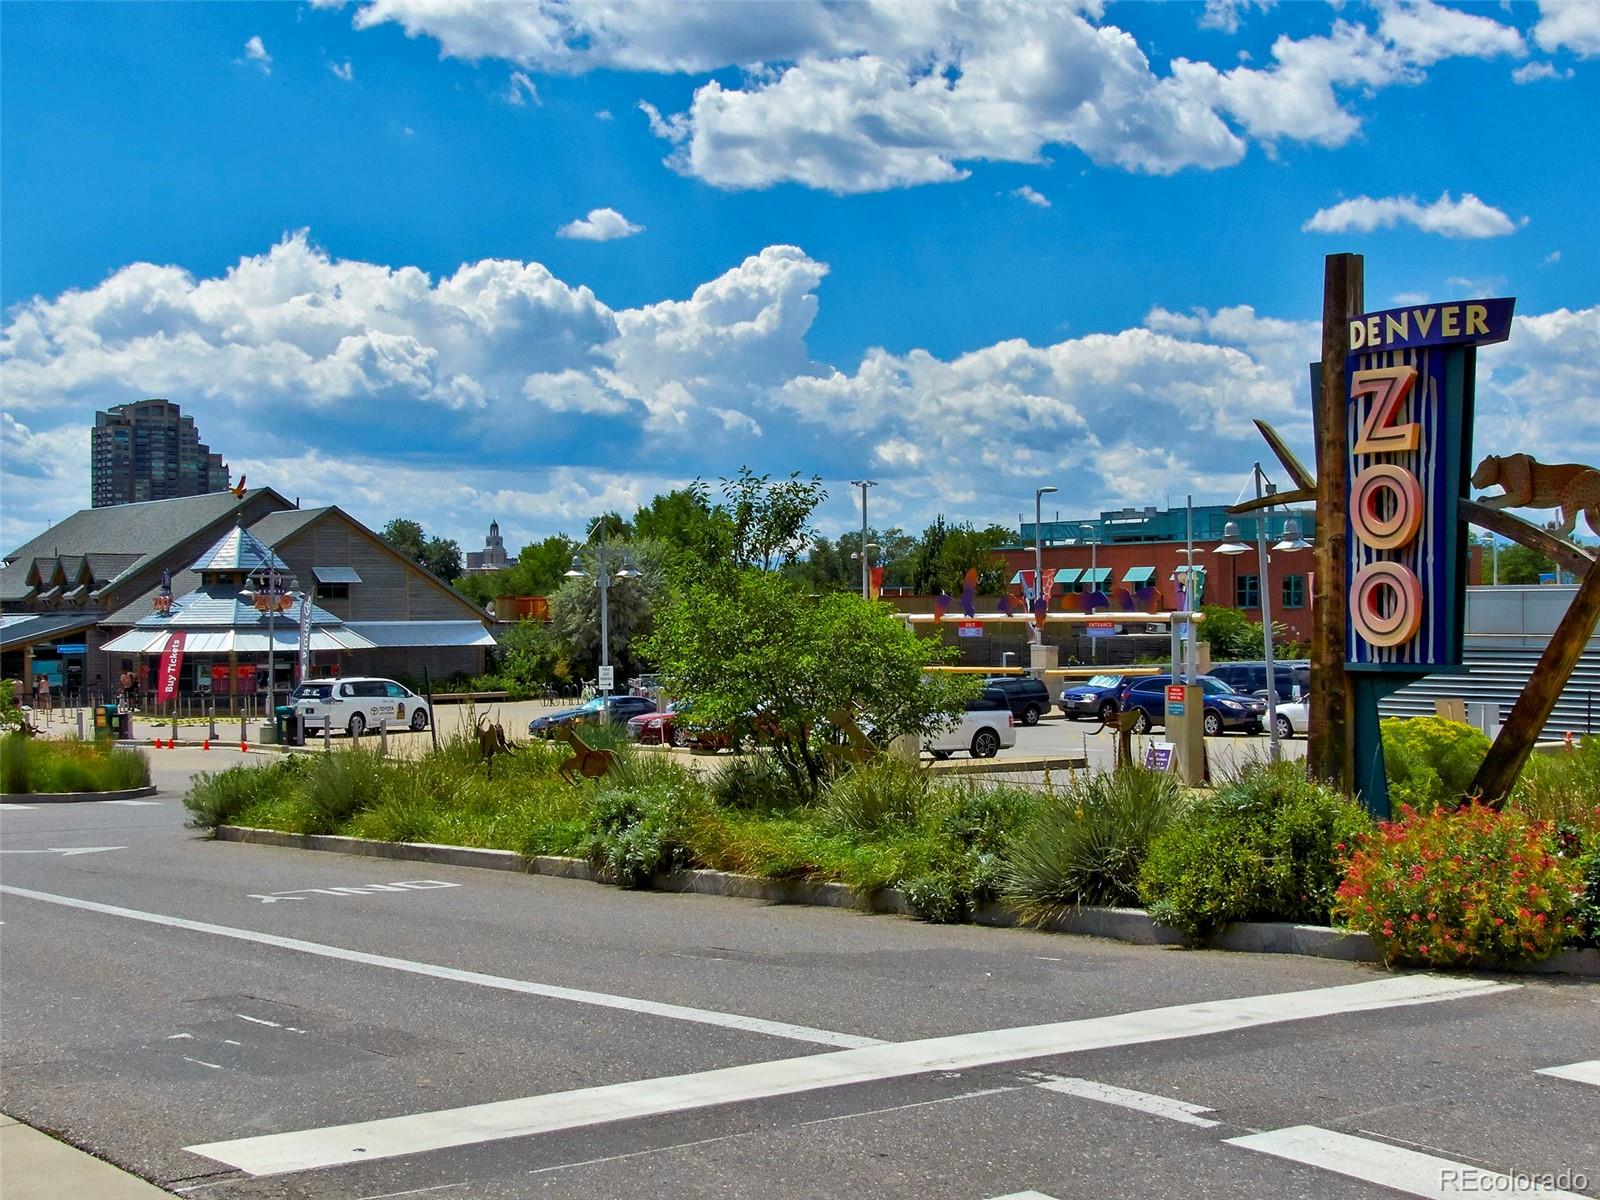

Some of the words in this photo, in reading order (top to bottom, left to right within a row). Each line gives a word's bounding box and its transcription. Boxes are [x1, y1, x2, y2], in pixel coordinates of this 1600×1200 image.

[1350, 304, 1490, 350] DENVER
[1350, 365, 1423, 647] ZOO
[168, 639, 180, 673] Tickets
[165, 675, 176, 693] Buy
